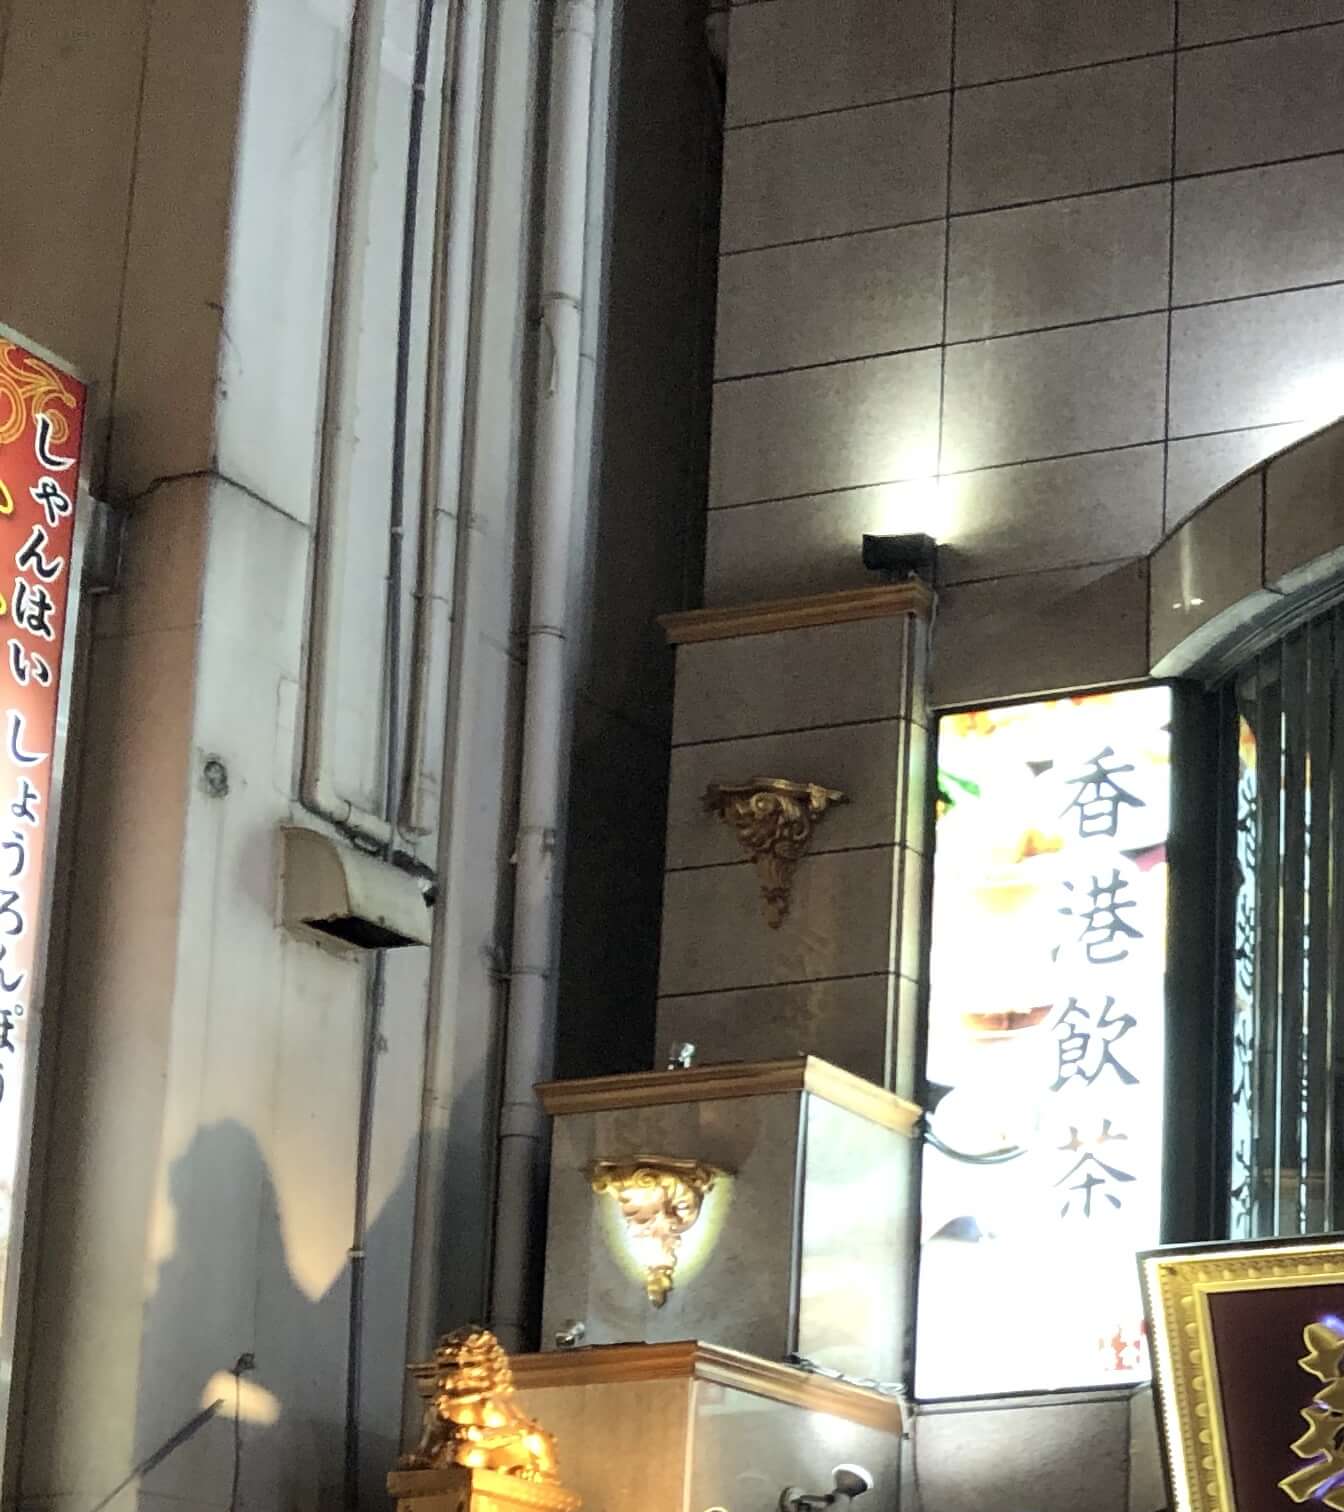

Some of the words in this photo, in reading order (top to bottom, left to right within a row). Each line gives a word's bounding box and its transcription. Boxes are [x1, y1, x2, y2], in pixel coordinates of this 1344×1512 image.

[8, 412, 76, 686] しゃんはい
[1050, 747, 1145, 1219] 香港飲茶
